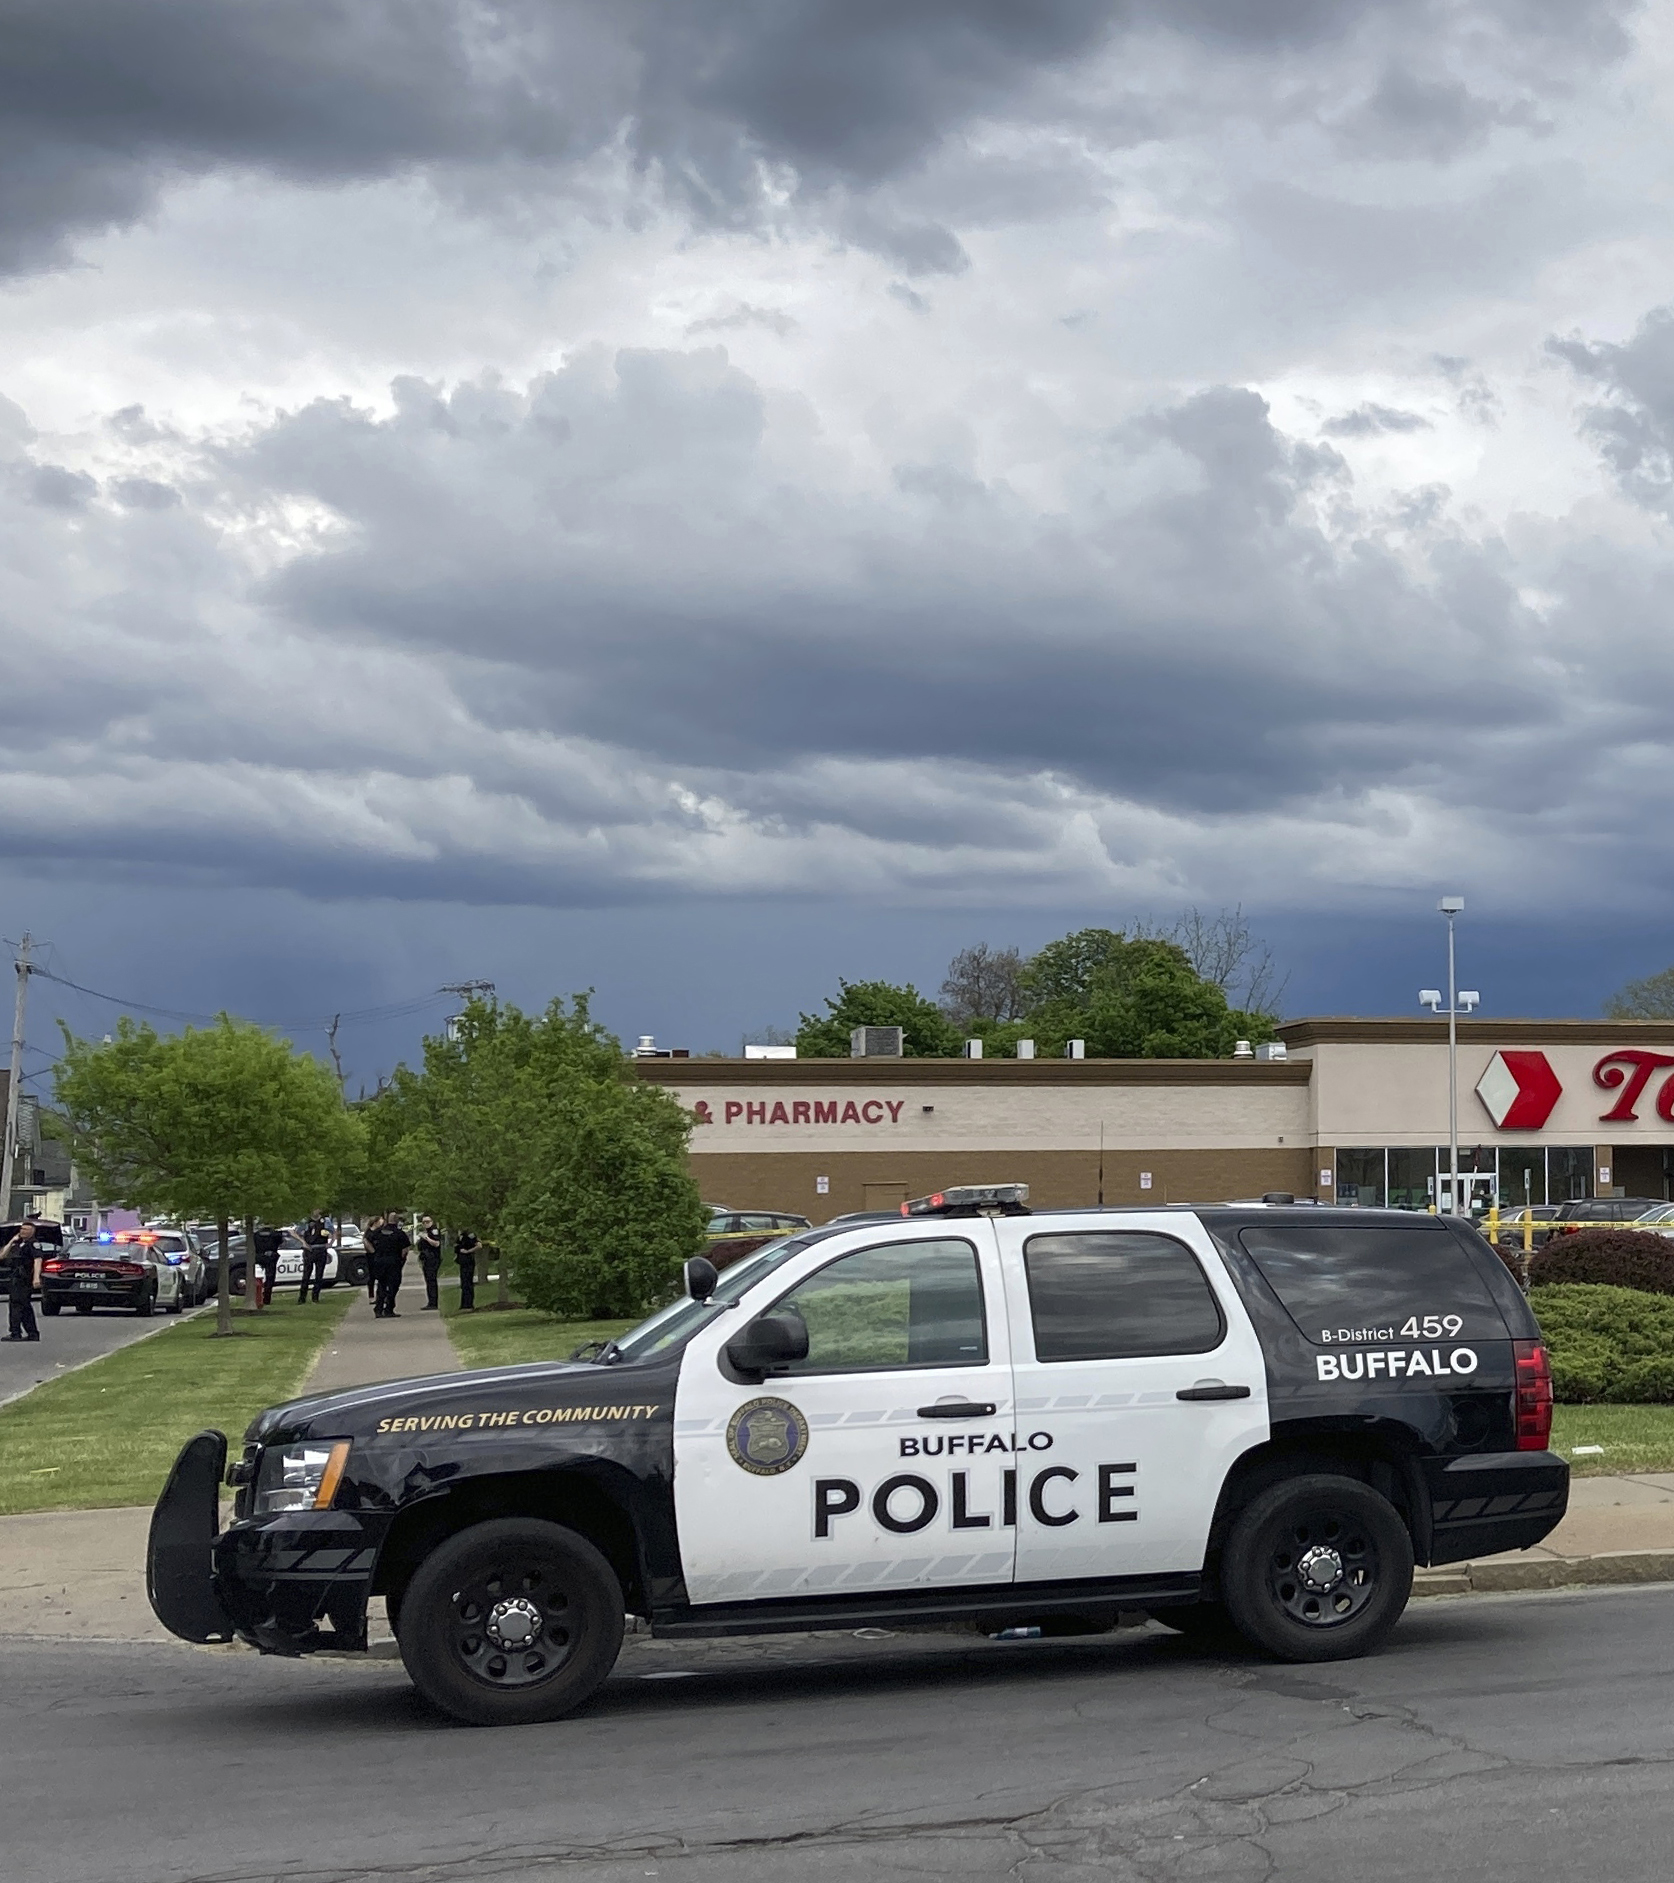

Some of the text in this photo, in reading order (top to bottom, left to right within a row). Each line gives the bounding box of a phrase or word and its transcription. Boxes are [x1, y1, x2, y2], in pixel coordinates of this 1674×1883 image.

[694, 1100, 905, 1124] & PHARMACY
[1322, 1314, 1463, 1342] B-District 459
[1316, 1348, 1478, 1381] BUFFALO
[376, 1404, 659, 1433] SERVING THE COMMUNITY
[900, 1431, 1054, 1458] BUFFALO
[814, 1461, 1138, 1538] POLICE
